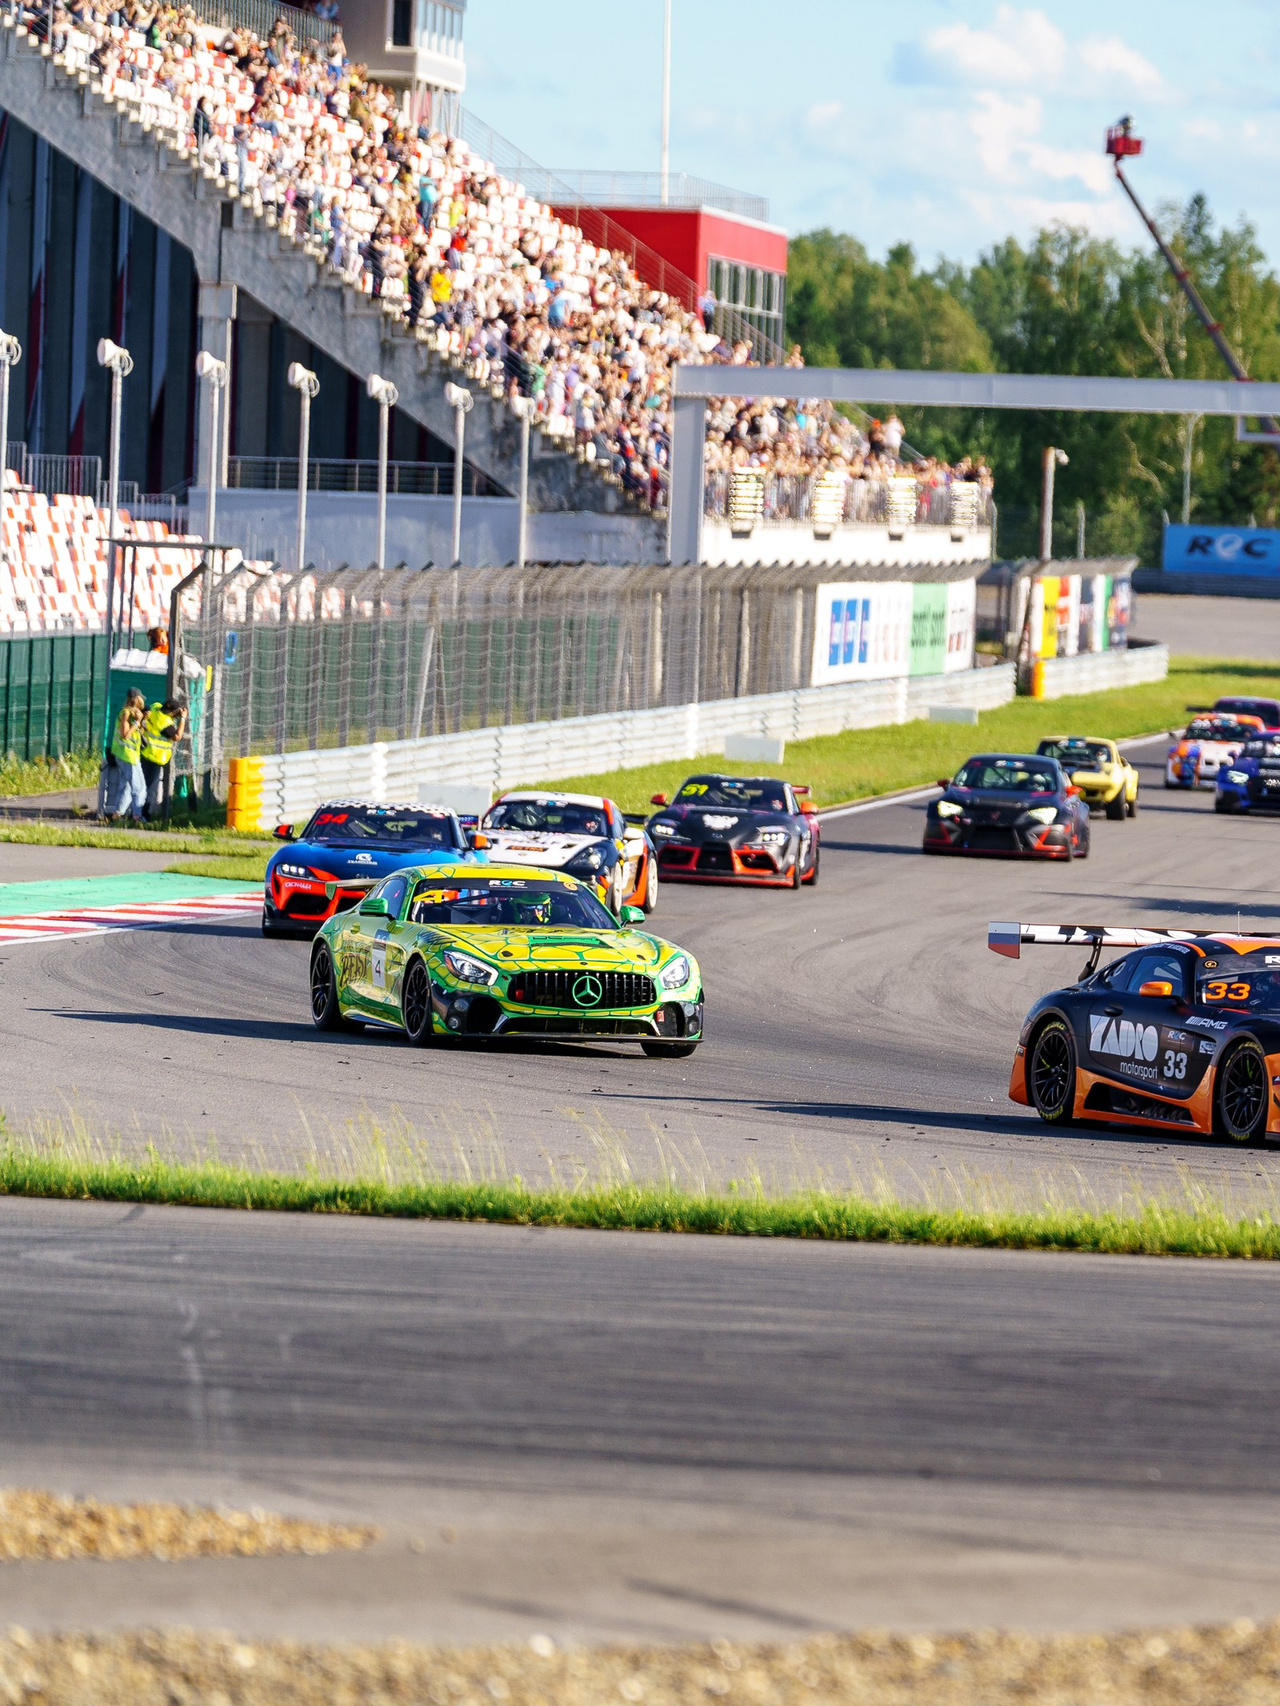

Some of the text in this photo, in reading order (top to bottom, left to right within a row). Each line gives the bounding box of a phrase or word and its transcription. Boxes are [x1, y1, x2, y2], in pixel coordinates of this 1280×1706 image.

[314, 813, 349, 825] 34
[1205, 982, 1250, 1000] 33
[1198, 1018, 1229, 1030] AMG
[1090, 1014, 1159, 1062] YADRO
[1120, 1061, 1159, 1081] motorsport
[1163, 1049, 1188, 1080] 33
